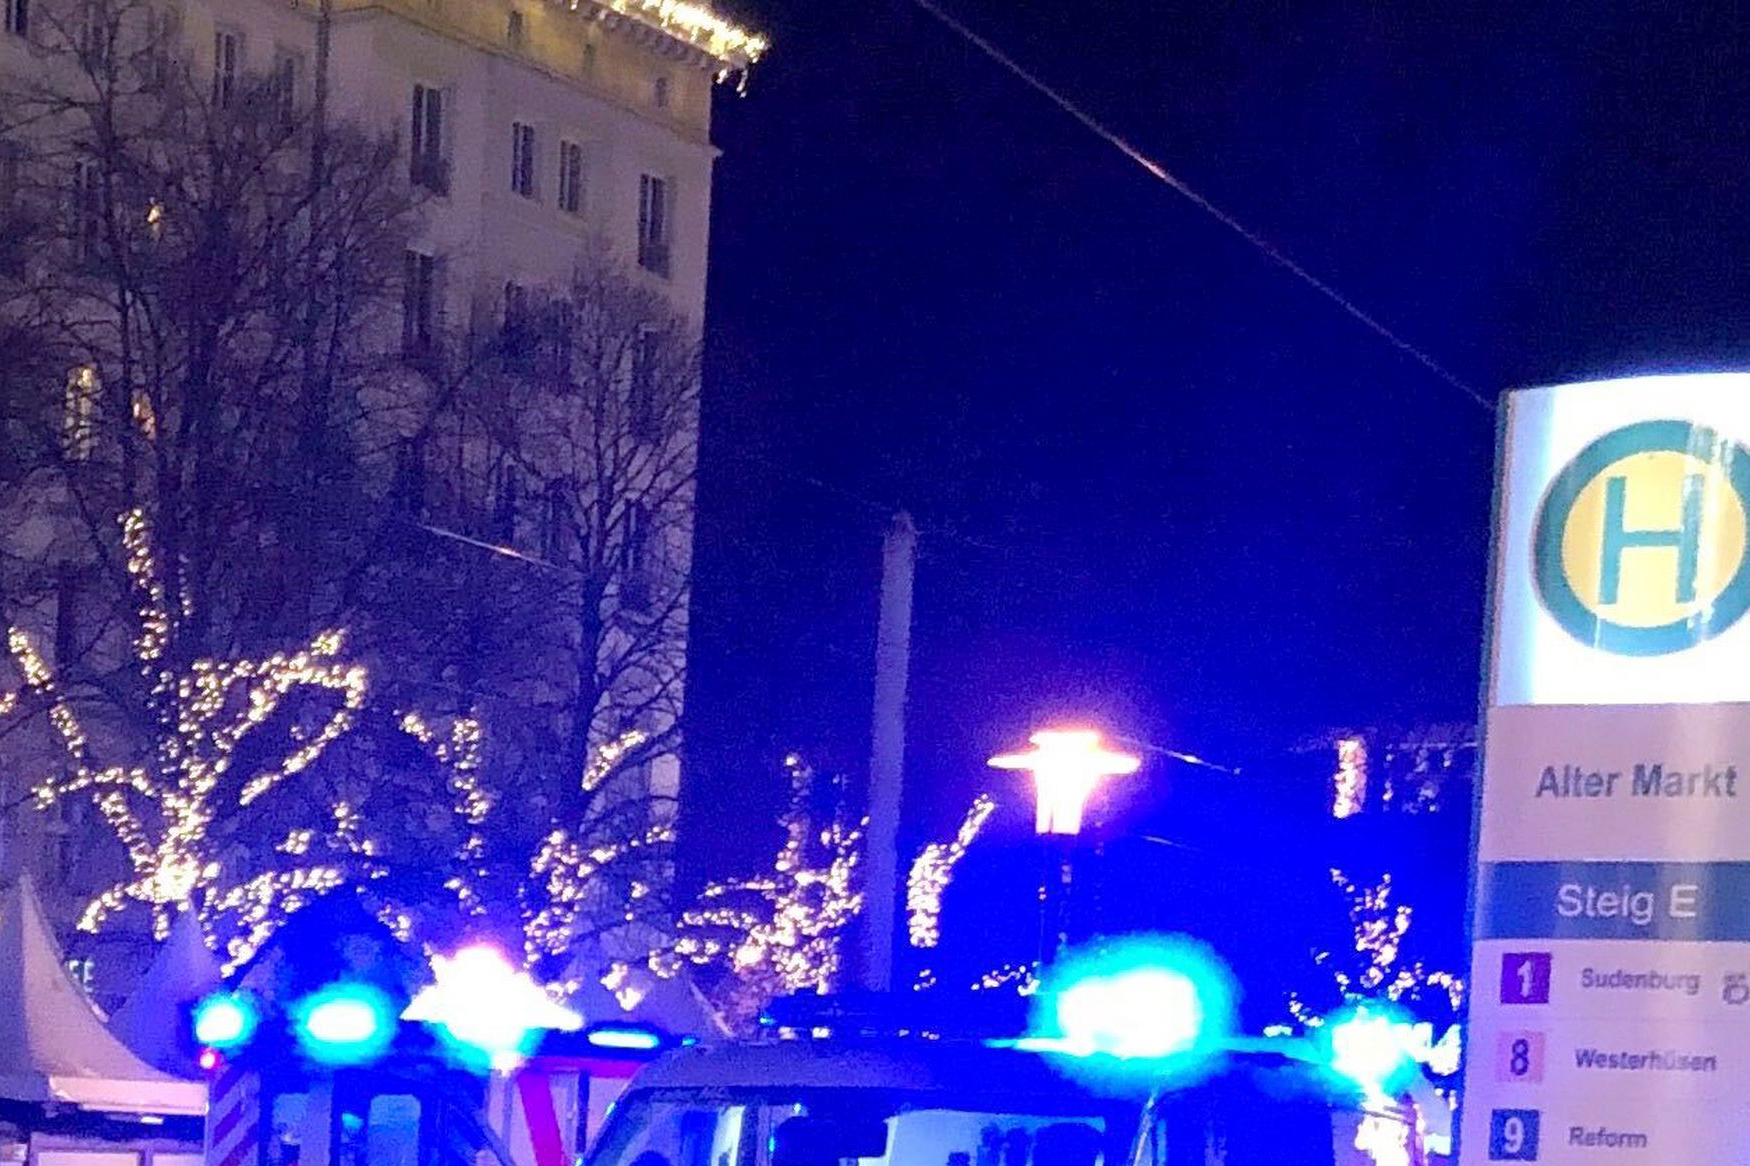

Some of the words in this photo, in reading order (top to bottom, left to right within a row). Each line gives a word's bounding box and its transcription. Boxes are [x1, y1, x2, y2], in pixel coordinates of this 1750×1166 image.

[1598, 474, 1705, 605] H
[1535, 764, 1621, 798] Alter
[1631, 763, 1737, 799] Markt
[1556, 884, 1654, 926] Steig
[1669, 884, 1699, 918] E
[1517, 961, 1535, 999] 1
[1581, 967, 1701, 996] Sudenburg
[1510, 1038, 1530, 1076] 8
[1575, 1049, 1718, 1071] Westerhüsen
[1504, 1116, 1525, 1154] 9
[1568, 1126, 1648, 1149] Reform
